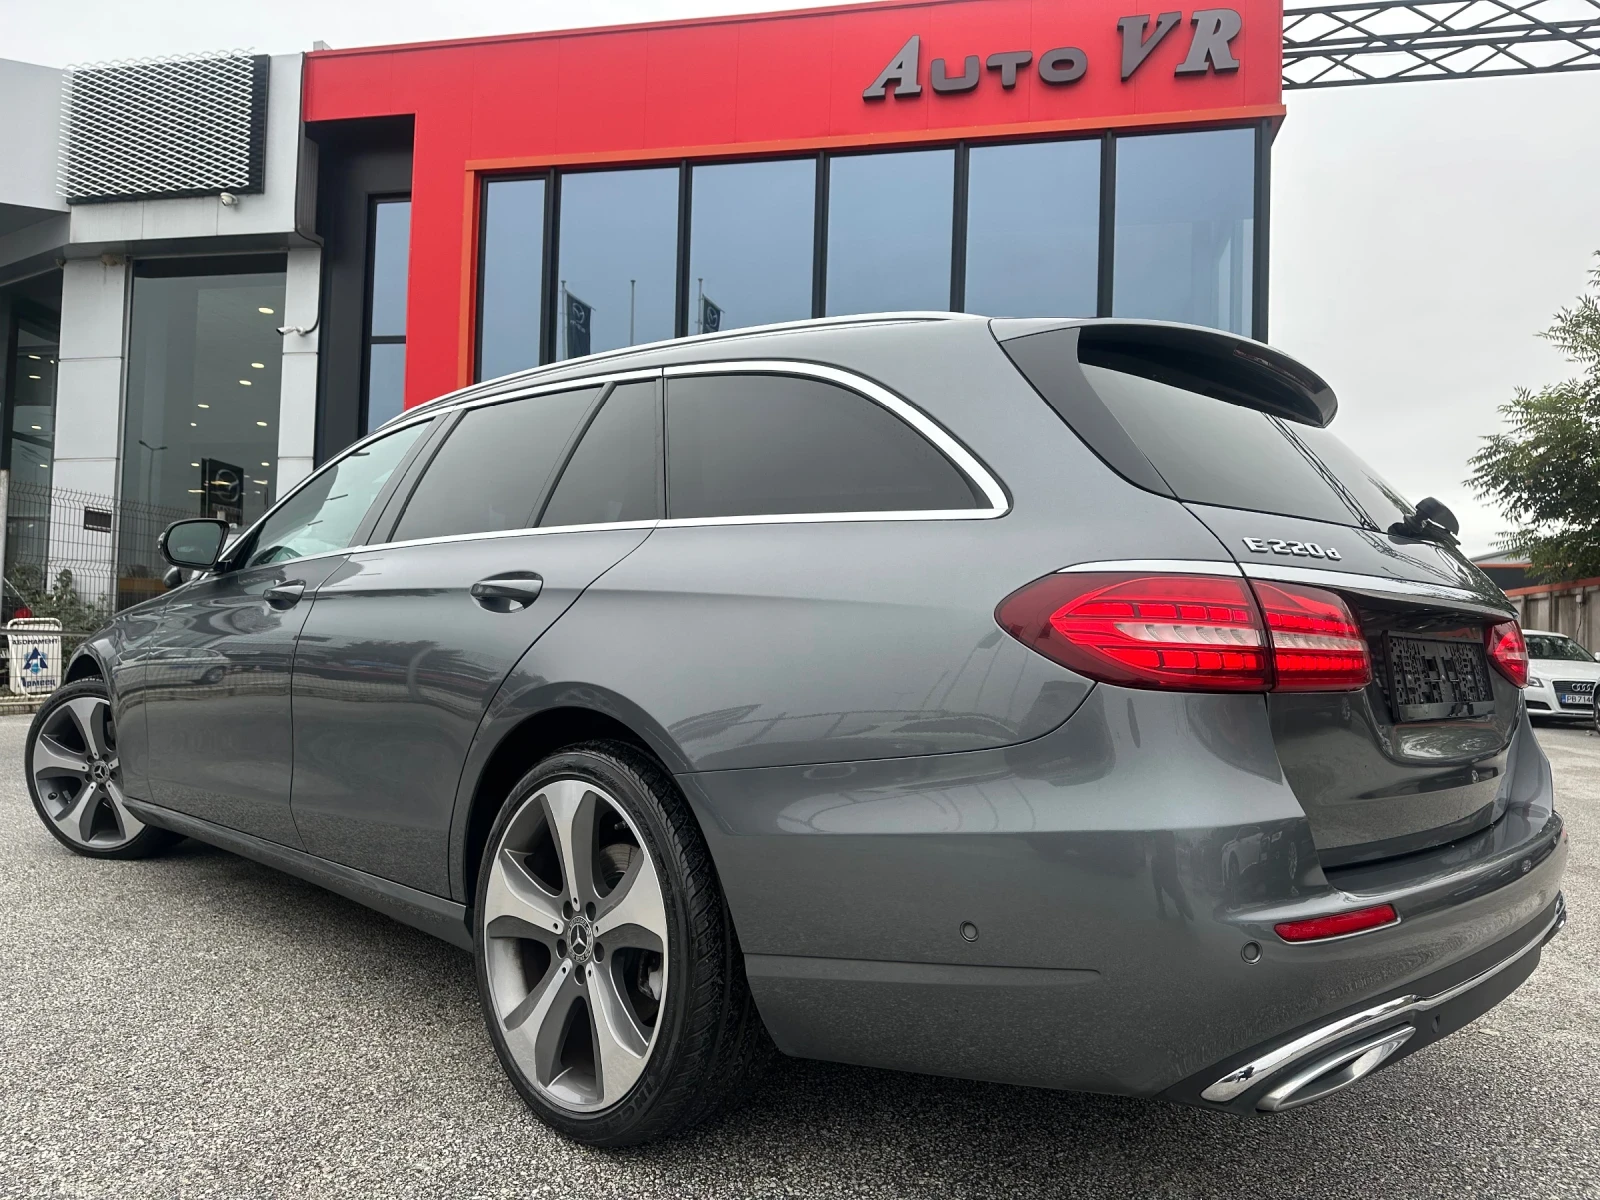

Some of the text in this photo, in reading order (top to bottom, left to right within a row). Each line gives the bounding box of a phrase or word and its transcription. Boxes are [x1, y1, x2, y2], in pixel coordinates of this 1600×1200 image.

[1117, 9, 1242, 82] VR
[1242, 537, 1342, 561] E 220d
